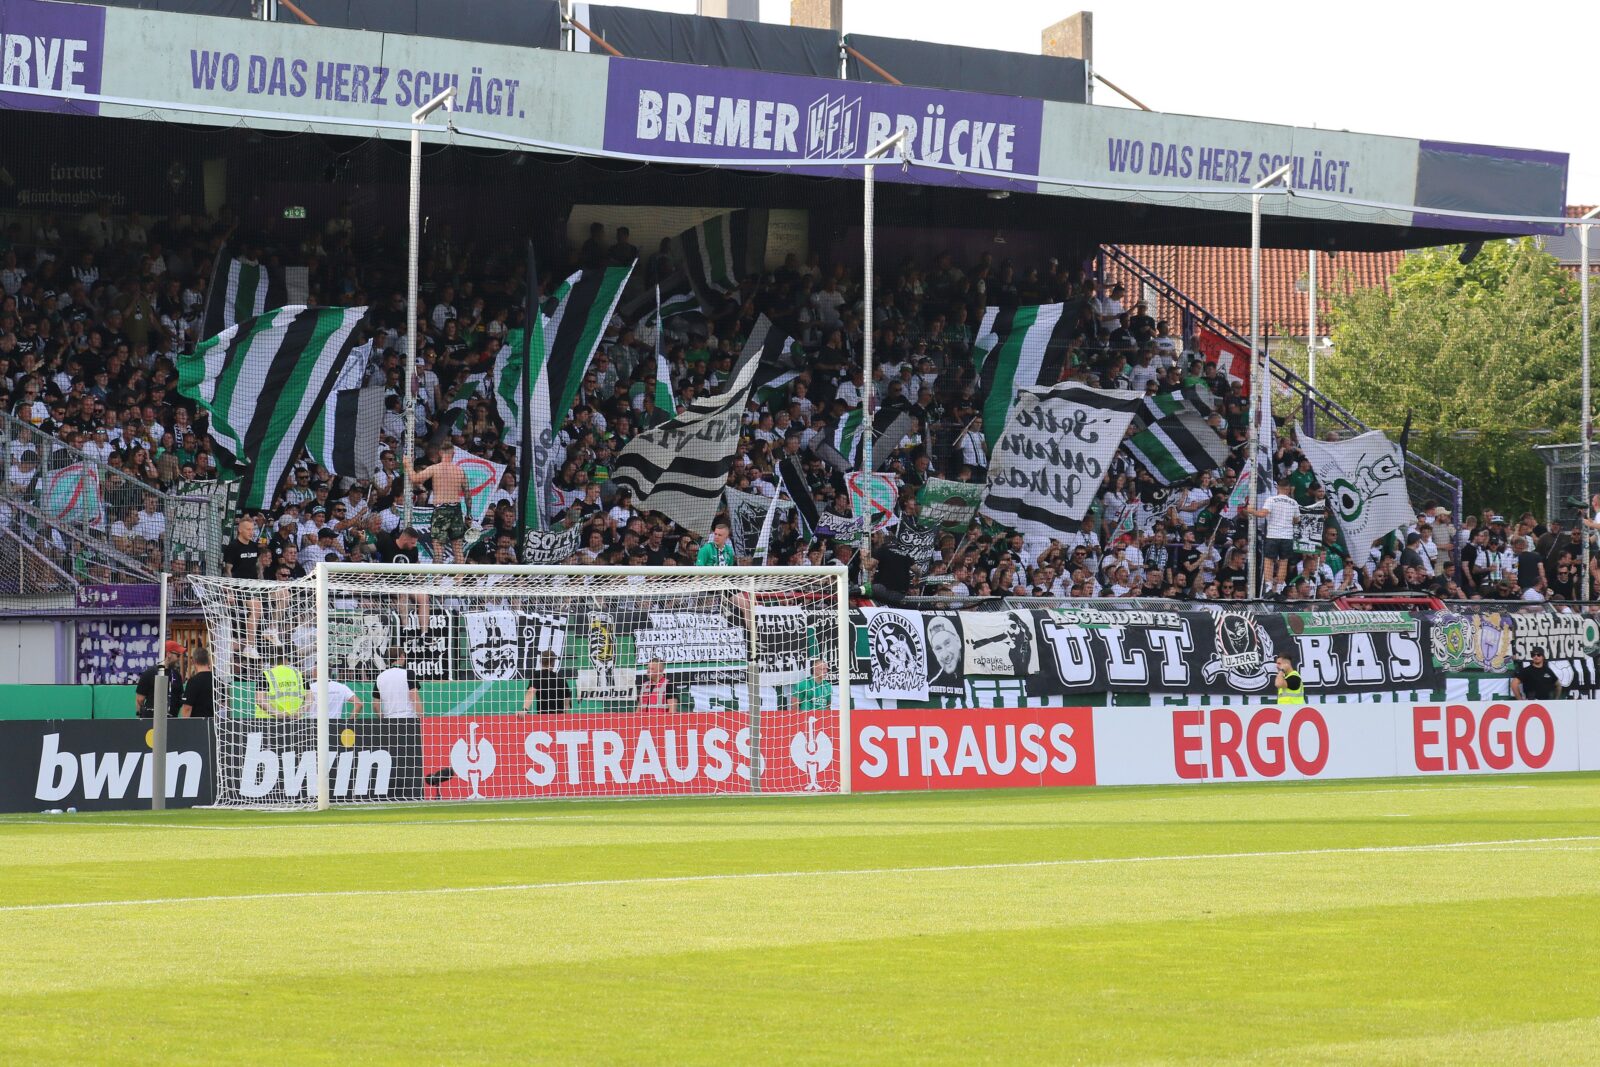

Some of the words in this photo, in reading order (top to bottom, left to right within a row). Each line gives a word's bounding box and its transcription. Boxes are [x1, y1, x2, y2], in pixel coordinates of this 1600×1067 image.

[0, 33, 88, 93] RVE
[190, 50, 239, 92] WO
[247, 56, 308, 97] DAS
[315, 62, 388, 106] HERZ
[396, 67, 525, 119] SCHLÄGT.
[637, 89, 799, 153] BREMER
[866, 104, 1016, 171] BRÜCKE
[1107, 137, 1144, 175] WO
[1148, 143, 1193, 179] DAS
[1198, 147, 1252, 185] HERZ
[1257, 151, 1353, 194] SCHLÄGT.
[1052, 610, 1182, 628] ASCENDENTE
[1312, 610, 1405, 626] STADIONVERBOT
[1513, 612, 1585, 637] BEGLEIT
[973, 655, 1003, 667] rabauke
[1225, 654, 1256, 665] ULTRAS
[1515, 634, 1584, 660] SERVICE
[869, 668, 925, 692] ACKERBANDE
[35, 728, 202, 800] bwin
[239, 728, 392, 798] bwin
[524, 727, 765, 787] STRAUSS
[859, 723, 1077, 778] STRAUSS
[1172, 706, 1330, 779] ERGO
[1412, 703, 1556, 772] ERGO
